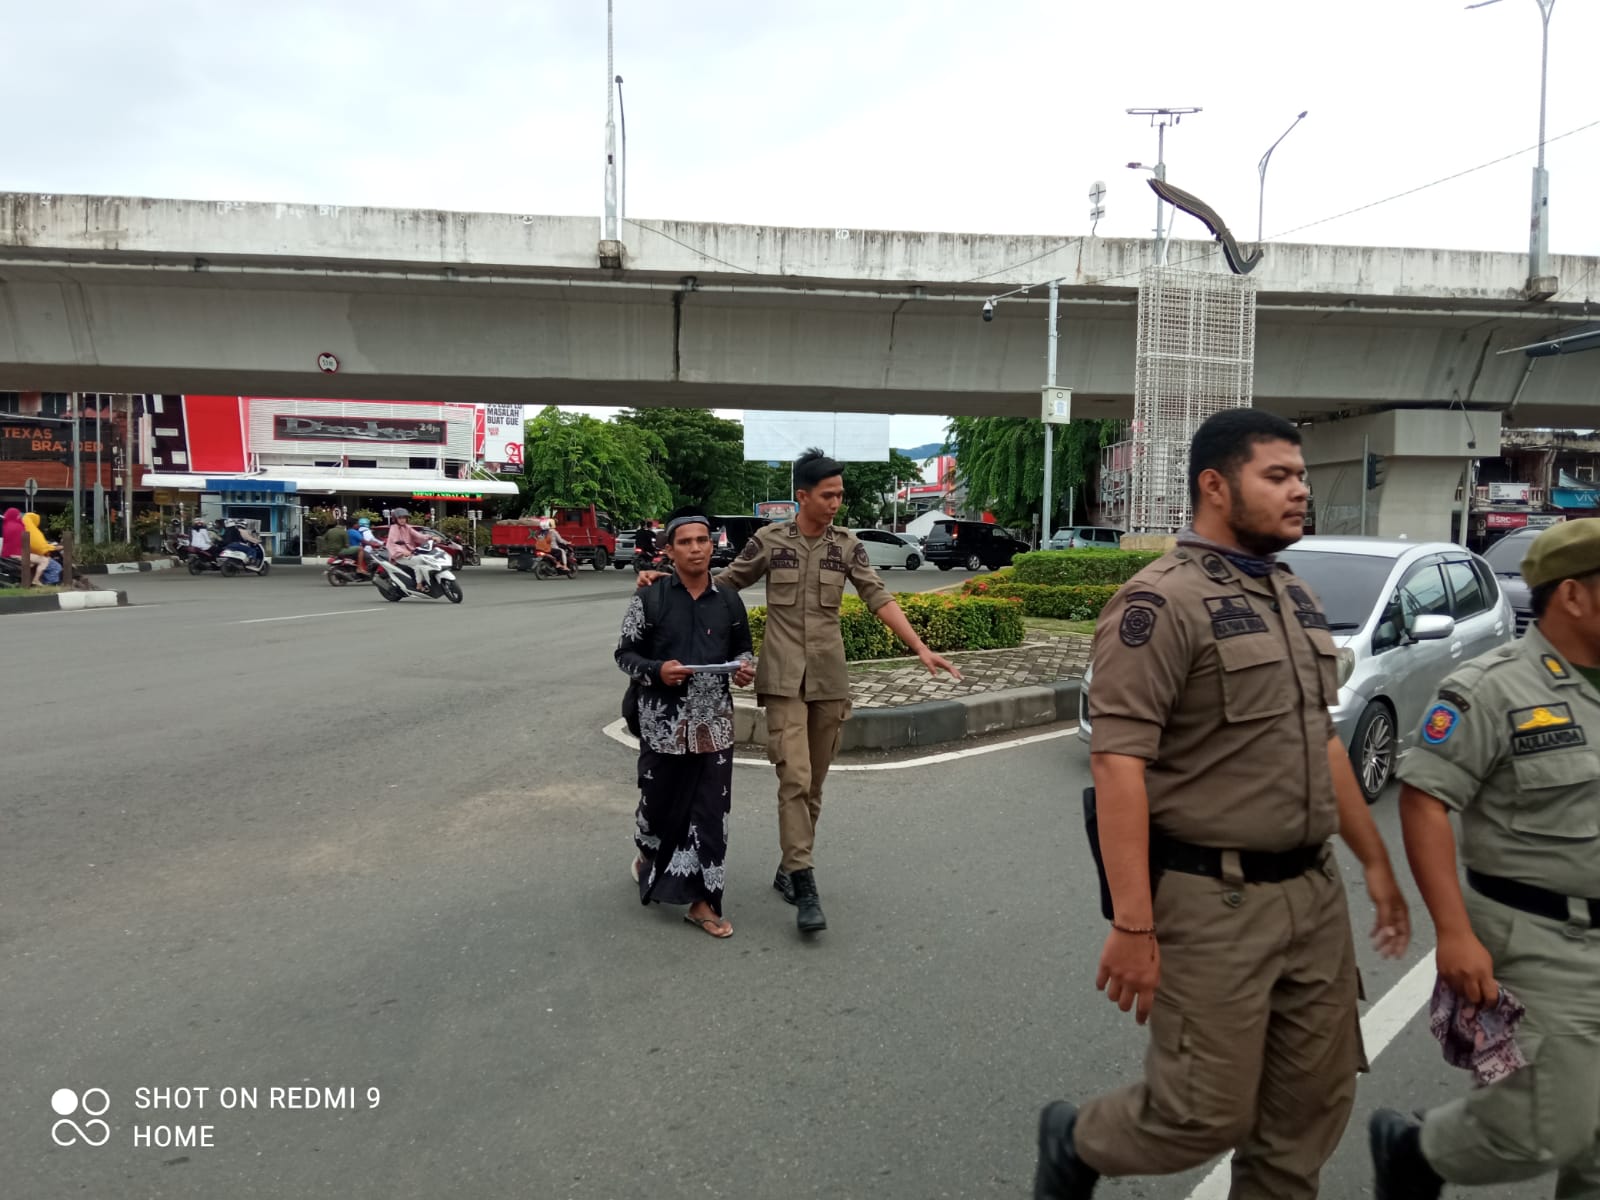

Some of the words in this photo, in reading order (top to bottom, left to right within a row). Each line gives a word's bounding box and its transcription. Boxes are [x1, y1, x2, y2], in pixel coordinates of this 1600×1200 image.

[487, 408, 519, 417] MASALAH
[487, 416, 504, 424] BUAT
[505, 417, 519, 425] GUE
[3, 427, 52, 439] TEXAS
[1495, 515, 1512, 524] SRC
